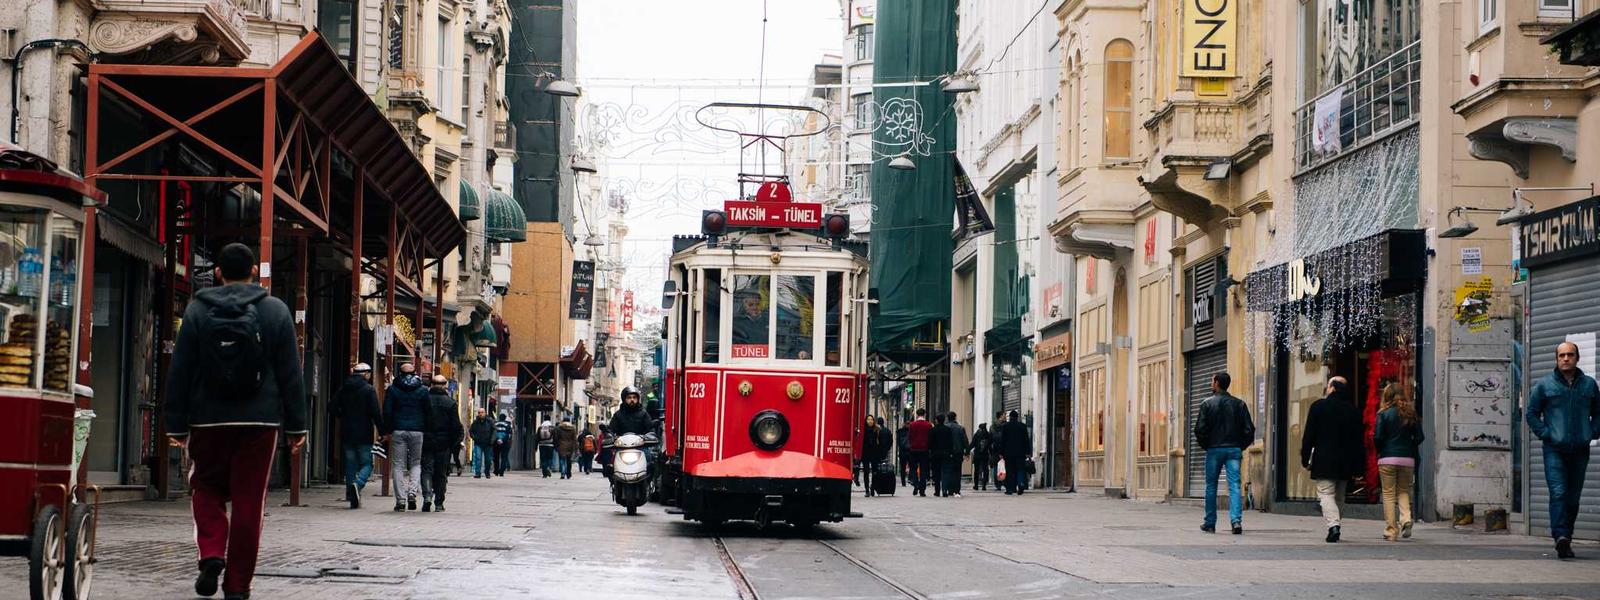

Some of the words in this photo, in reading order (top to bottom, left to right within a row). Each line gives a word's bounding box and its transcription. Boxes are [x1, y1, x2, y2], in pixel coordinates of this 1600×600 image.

[769, 183, 778, 198] 2
[729, 205, 766, 221] TAKSİM
[784, 206, 819, 223] TÜNEL
[733, 345, 768, 357] TÜNEL
[689, 382, 706, 398] 223
[835, 388, 851, 404] 223
